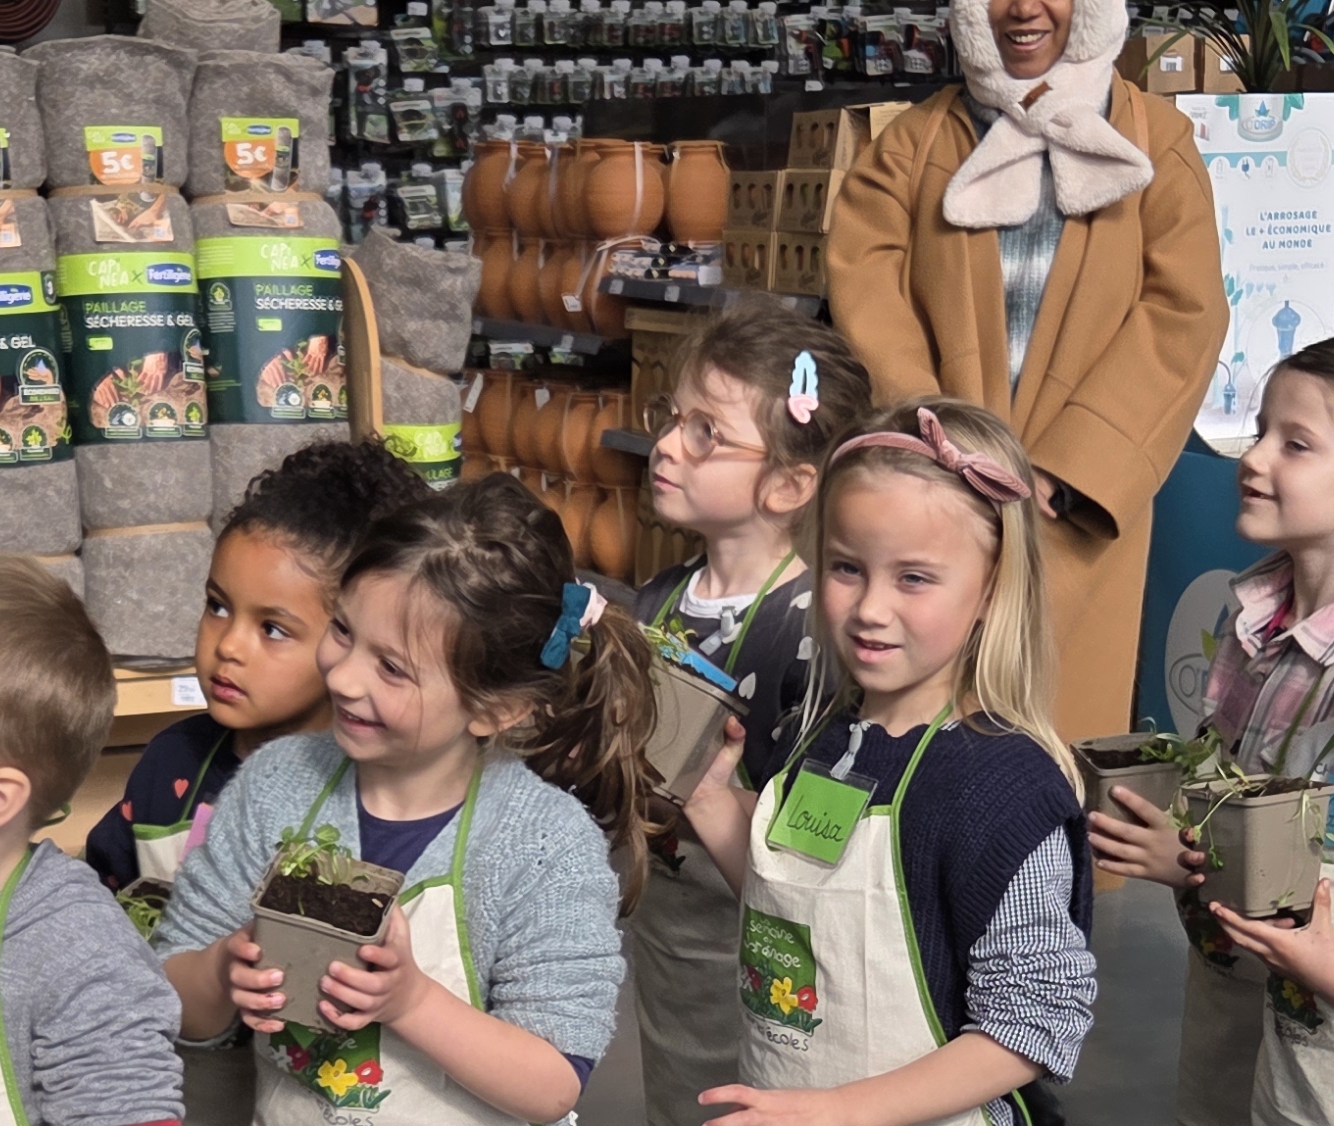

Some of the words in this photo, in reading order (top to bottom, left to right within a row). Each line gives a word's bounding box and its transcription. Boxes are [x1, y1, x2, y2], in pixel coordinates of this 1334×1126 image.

[236, 143, 267, 165] 5€
[101, 151, 134, 174] 5€
[1260, 210, 1318, 222] L'ARROSAGE
[1245, 226, 1257, 236] LE
[1267, 223, 1332, 236] ÉCONOMIQUE
[1262, 240, 1276, 250] AU
[1279, 238, 1313, 249] MONDE
[256, 284, 313, 296] PAILLAGE
[85, 300, 146, 313] PAILLAGE
[256, 297, 327, 311] SÉCHERESSE
[328, 299, 334, 311] &
[85, 314, 165, 329] SÉCHERESSE
[167, 315, 175, 327] &
[177, 315, 195, 327] GEL
[0, 337, 9, 350] &
[11, 335, 36, 349] GEL
[786, 793, 844, 843] Louisa
